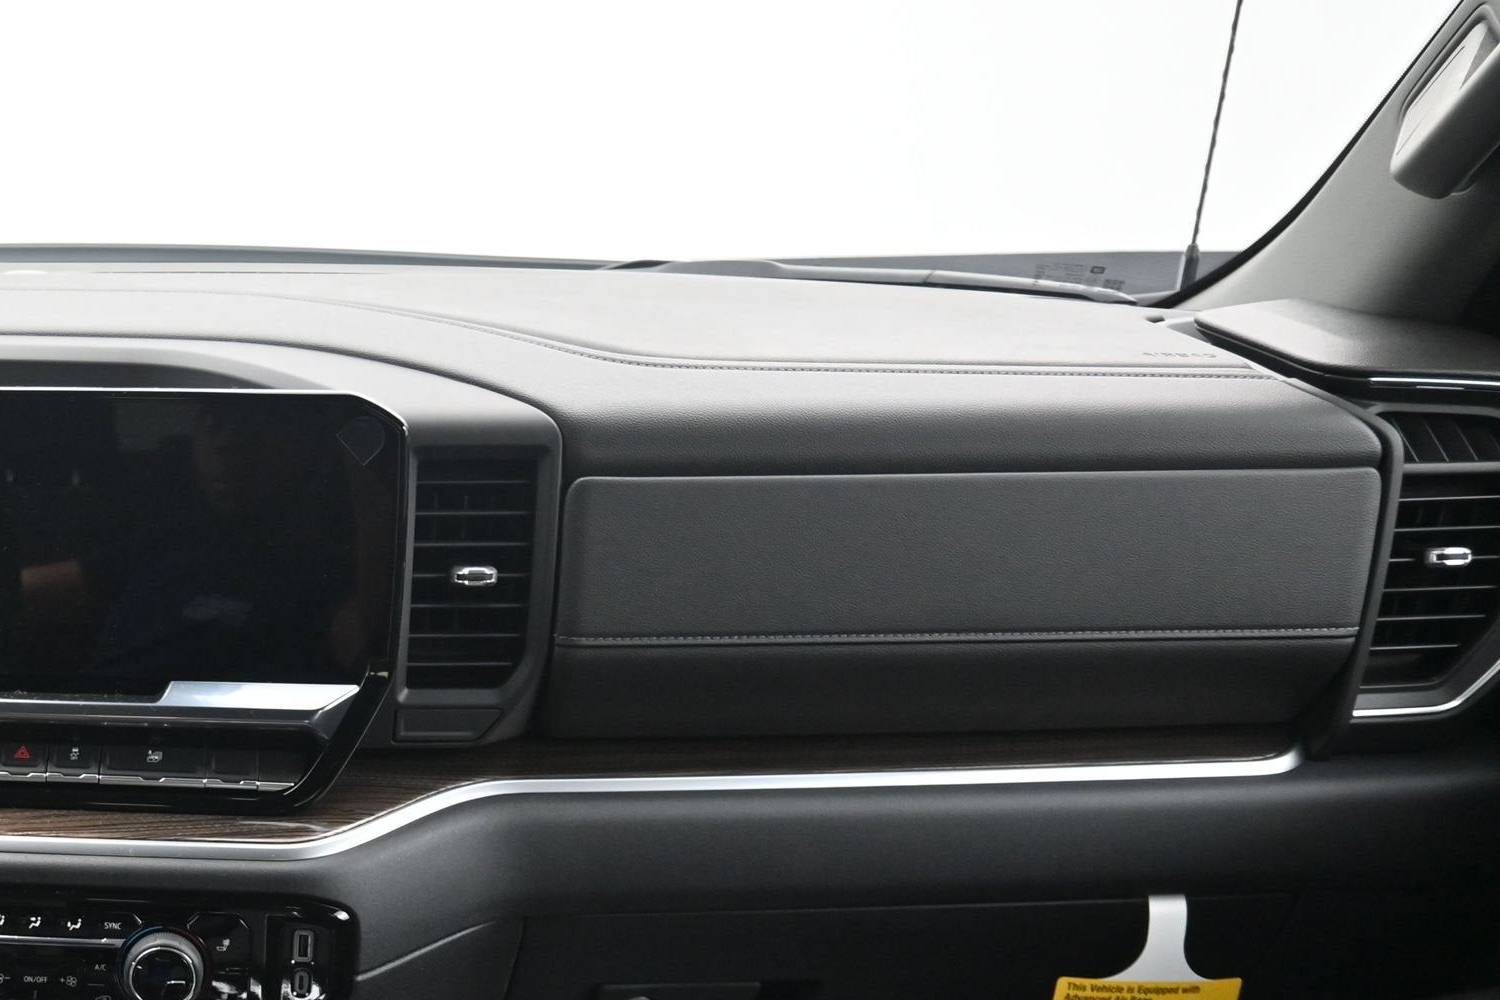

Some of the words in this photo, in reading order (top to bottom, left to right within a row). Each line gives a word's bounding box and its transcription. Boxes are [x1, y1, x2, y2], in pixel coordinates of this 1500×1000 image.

[103, 922, 122, 931] SYNC
[94, 963, 108, 972] A/C
[23, 975, 48, 984] ON/OFF
[1067, 982, 1087, 992] This
[1090, 984, 1125, 993] Vehicle
[1127, 986, 1135, 994] is
[1137, 985, 1180, 996] Equipped
[1181, 985, 1201, 994] with
